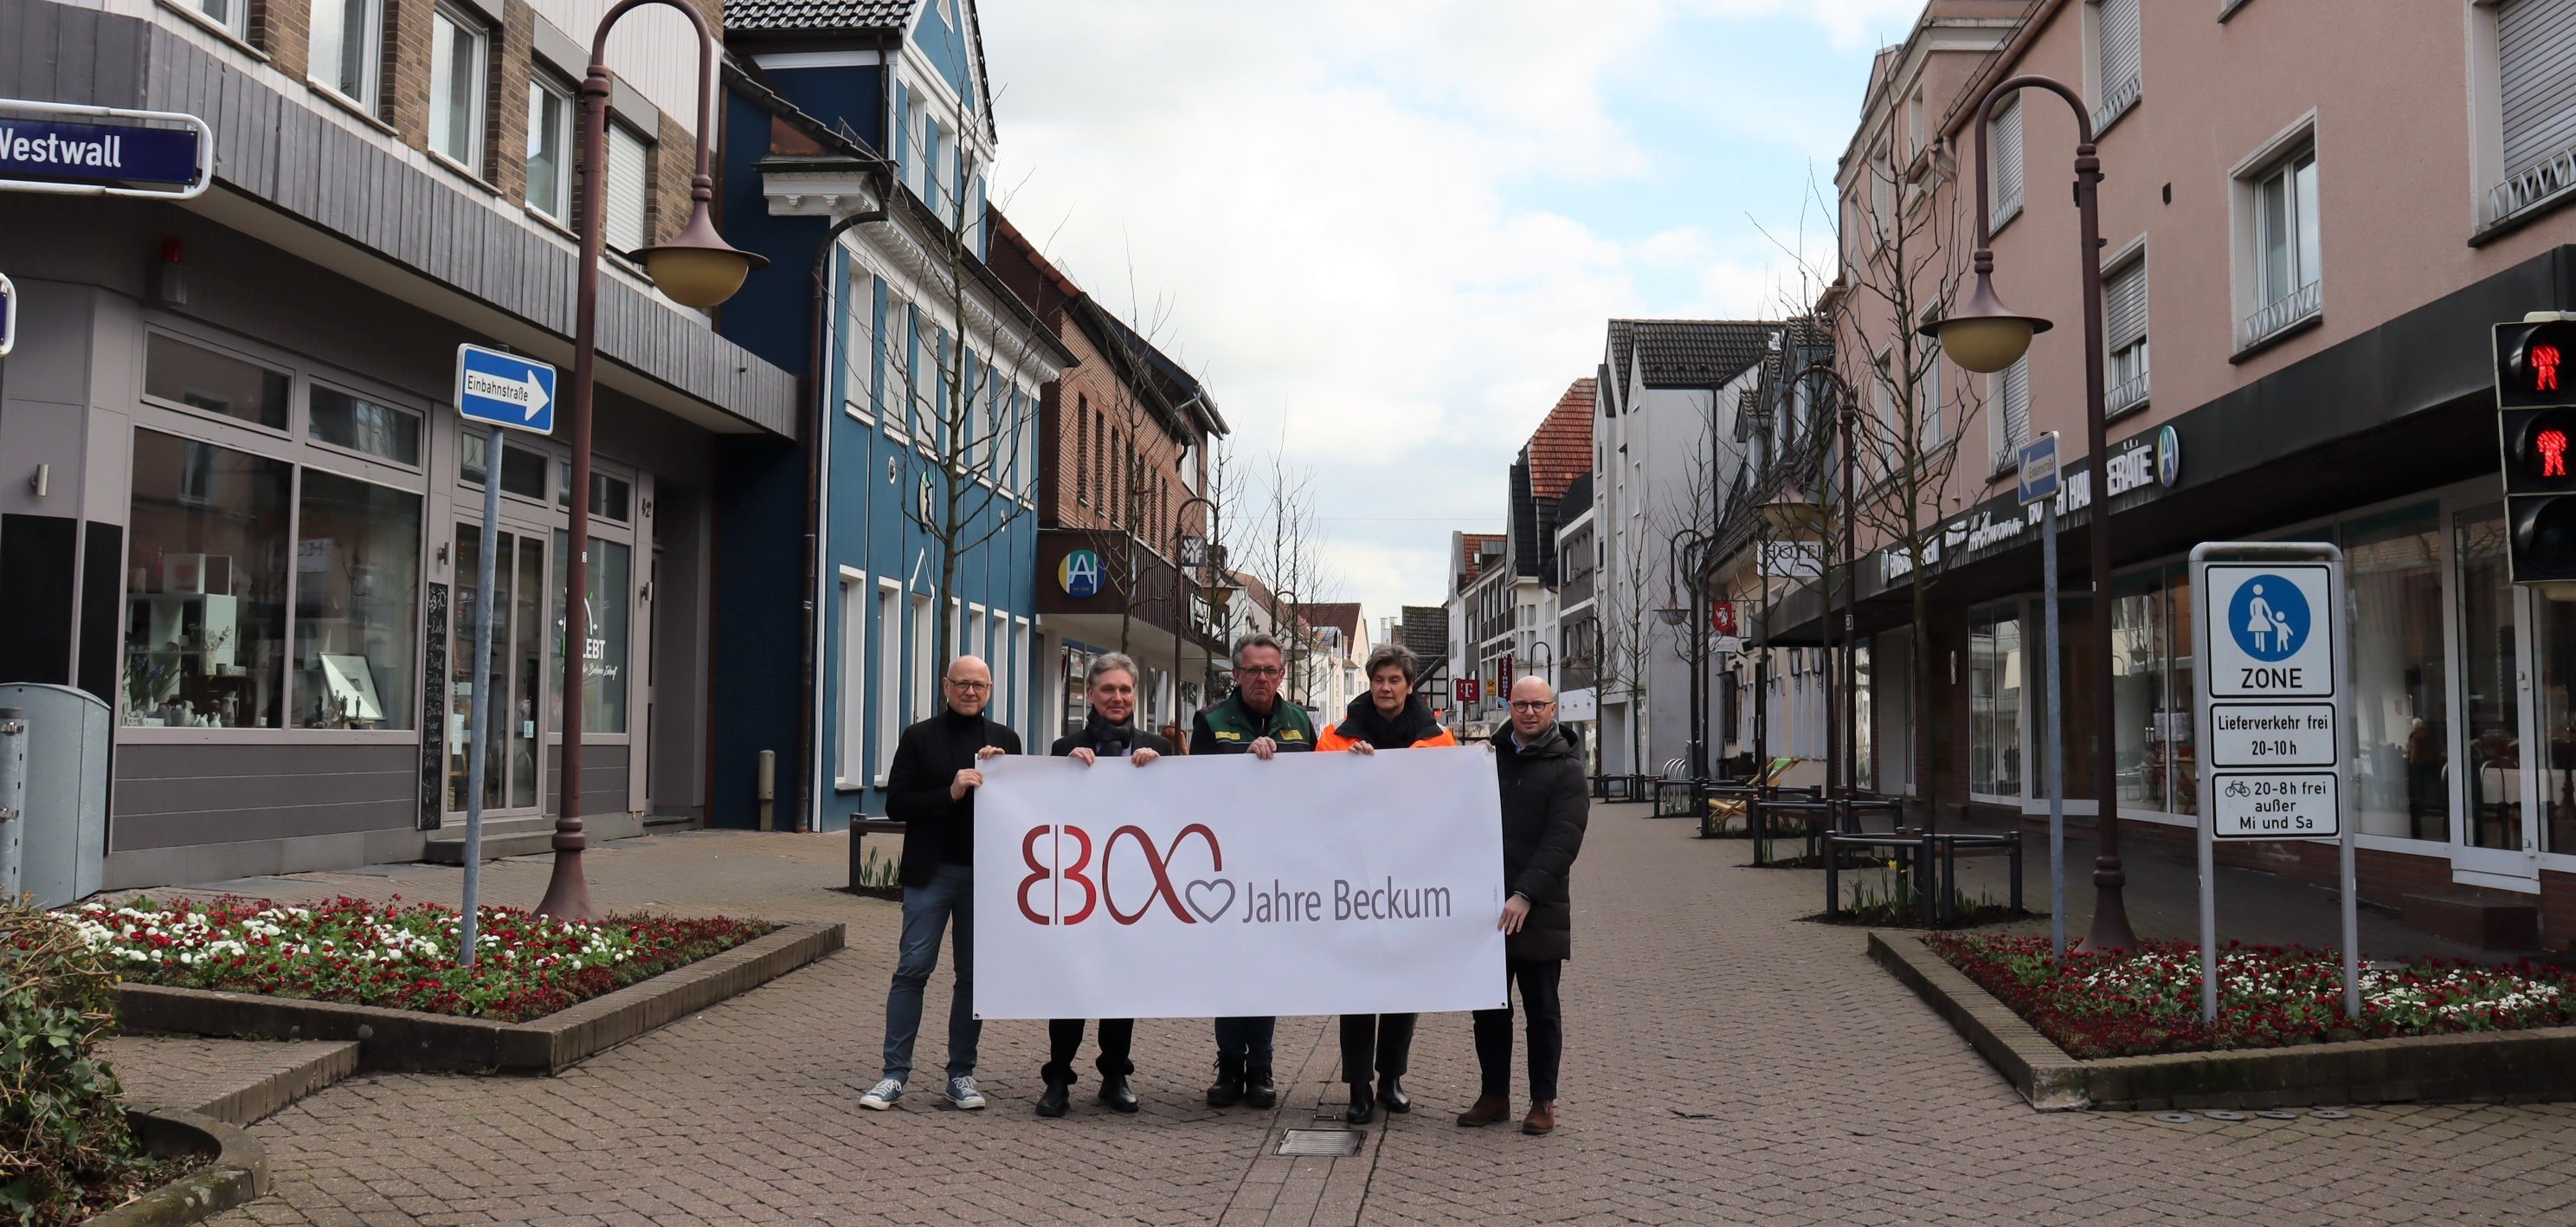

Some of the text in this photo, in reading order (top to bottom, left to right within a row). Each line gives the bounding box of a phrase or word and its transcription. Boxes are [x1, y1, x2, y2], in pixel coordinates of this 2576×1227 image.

[467, 375, 528, 402] Einbahnstraße
[2069, 440, 2154, 512] HAUERÄTE
[641, 498, 652, 518] 42
[1766, 545, 1824, 559] HOEL
[2241, 668, 2302, 688] ZONE
[2218, 715, 2328, 730] Lieferverkehr frei
[2302, 781, 2326, 795] frei
[2255, 799, 2296, 812] außer
[2240, 816, 2313, 830] Mi und Sa
[1242, 880, 1321, 924] Jahre
[1335, 876, 1452, 921] Beckum
